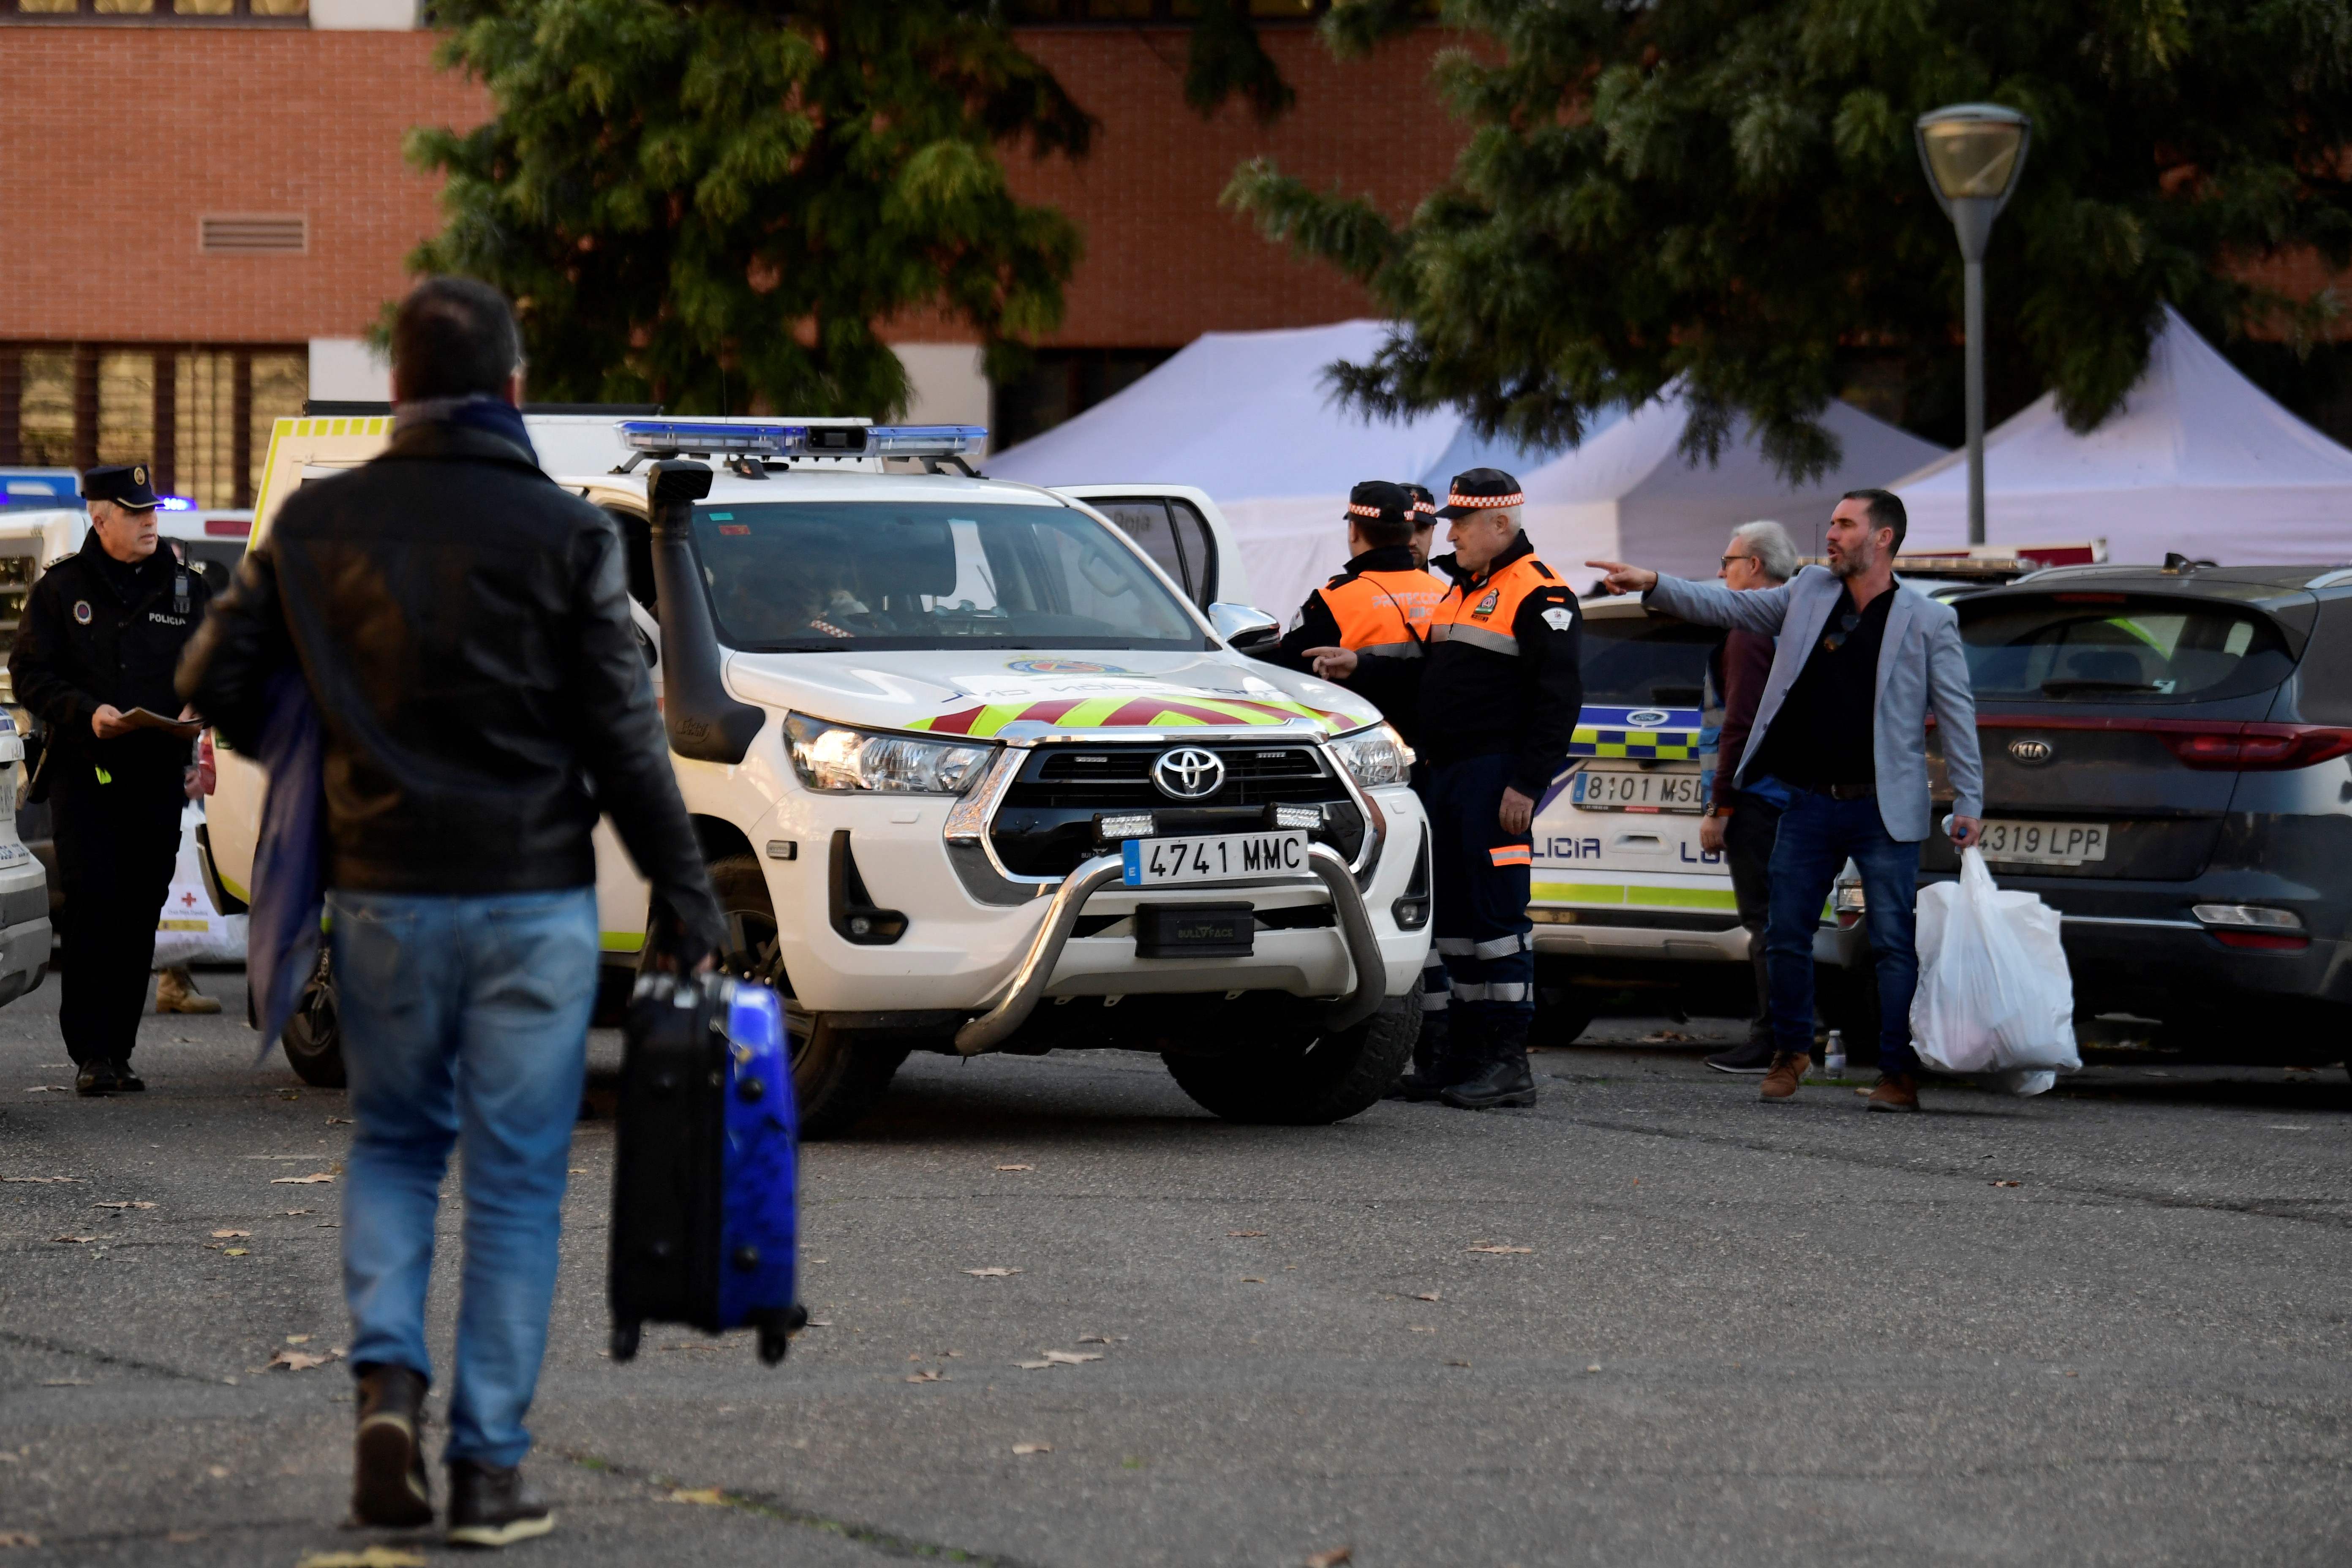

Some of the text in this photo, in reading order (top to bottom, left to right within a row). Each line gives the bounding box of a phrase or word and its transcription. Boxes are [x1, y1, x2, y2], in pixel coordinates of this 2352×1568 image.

[2018, 744, 2045, 757] KIA
[1588, 776, 1649, 801] 8101
[2049, 828, 2100, 855] LPP
[1129, 837, 1300, 877] E 4741 MMC
